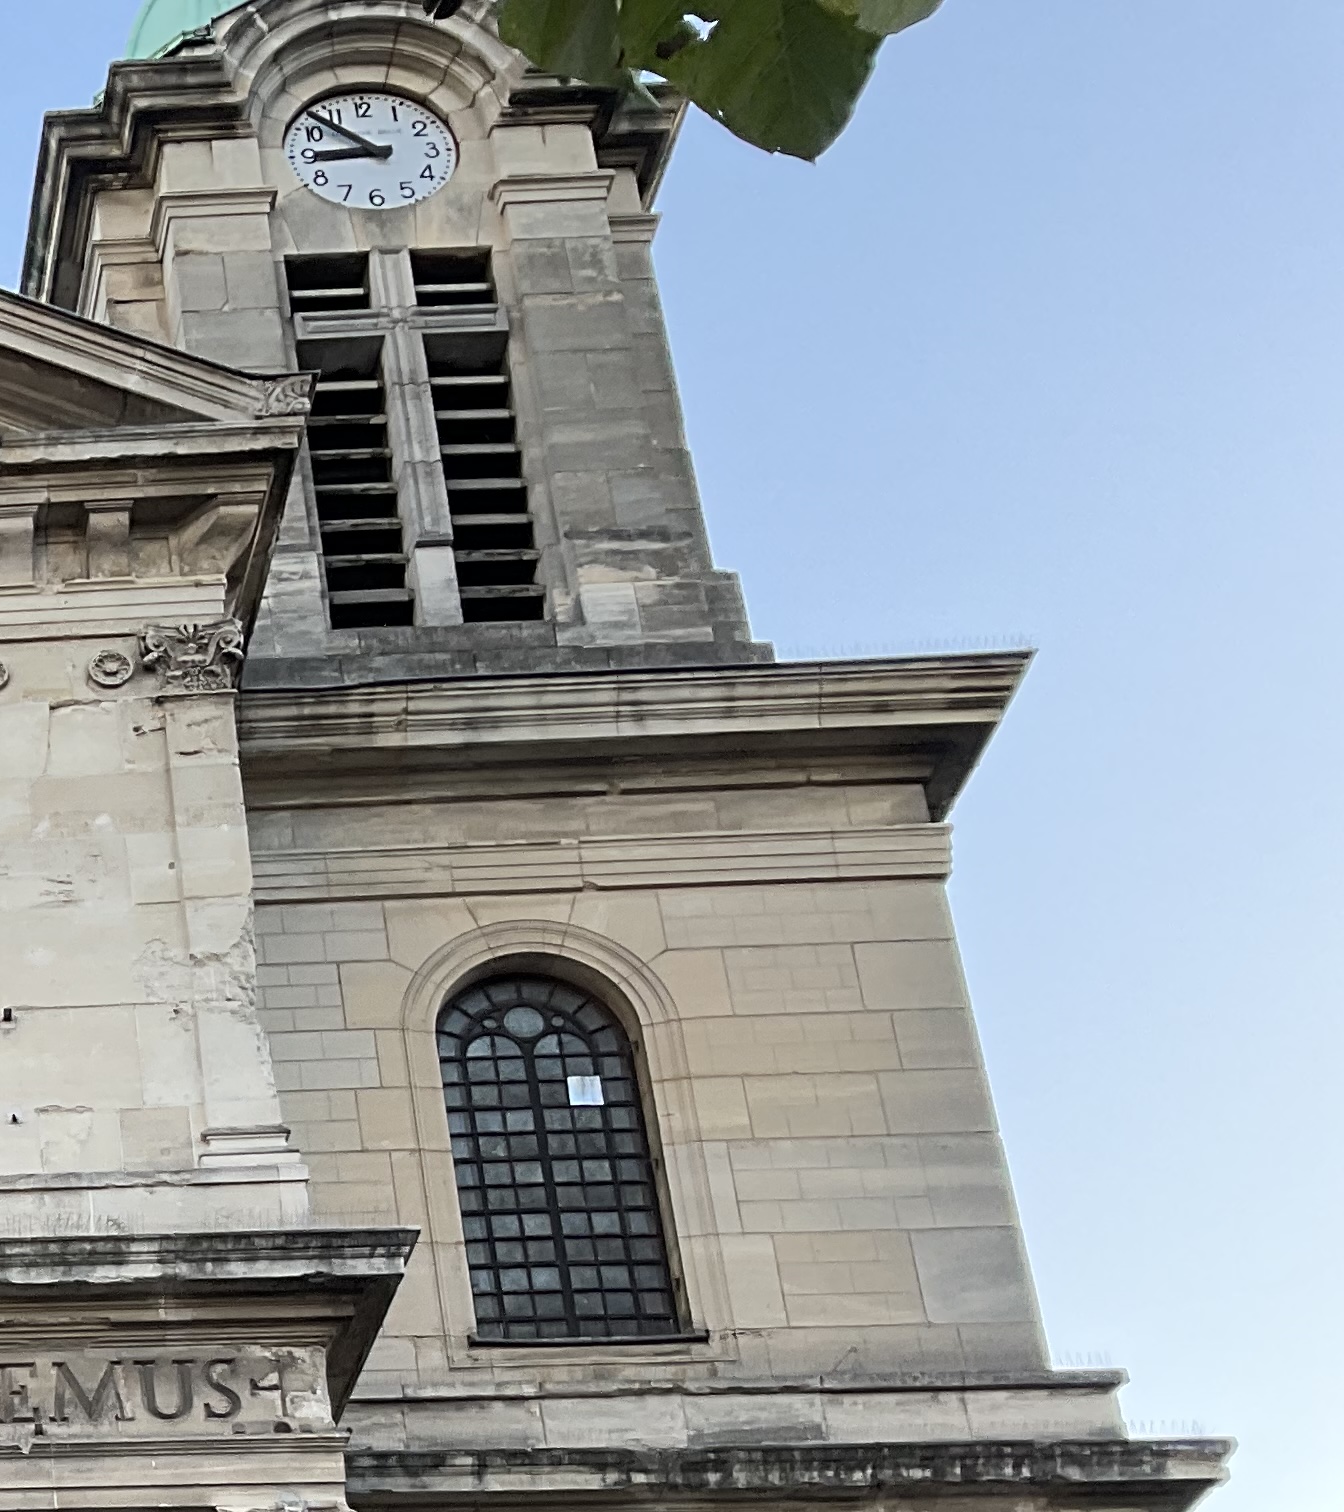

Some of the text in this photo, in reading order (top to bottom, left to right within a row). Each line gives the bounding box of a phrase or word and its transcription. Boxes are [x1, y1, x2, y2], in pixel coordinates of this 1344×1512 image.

[328, 108, 342, 125] 11
[354, 102, 373, 118] 12
[391, 106, 398, 122] 1
[306, 126, 323, 142] 10
[412, 120, 428, 136] 2
[301, 148, 316, 164] 9
[424, 142, 440, 158] 3
[314, 170, 328, 186] 8
[420, 164, 435, 181] 4
[337, 184, 352, 202] 7
[368, 189, 385, 206] 6
[400, 182, 415, 198] 5
